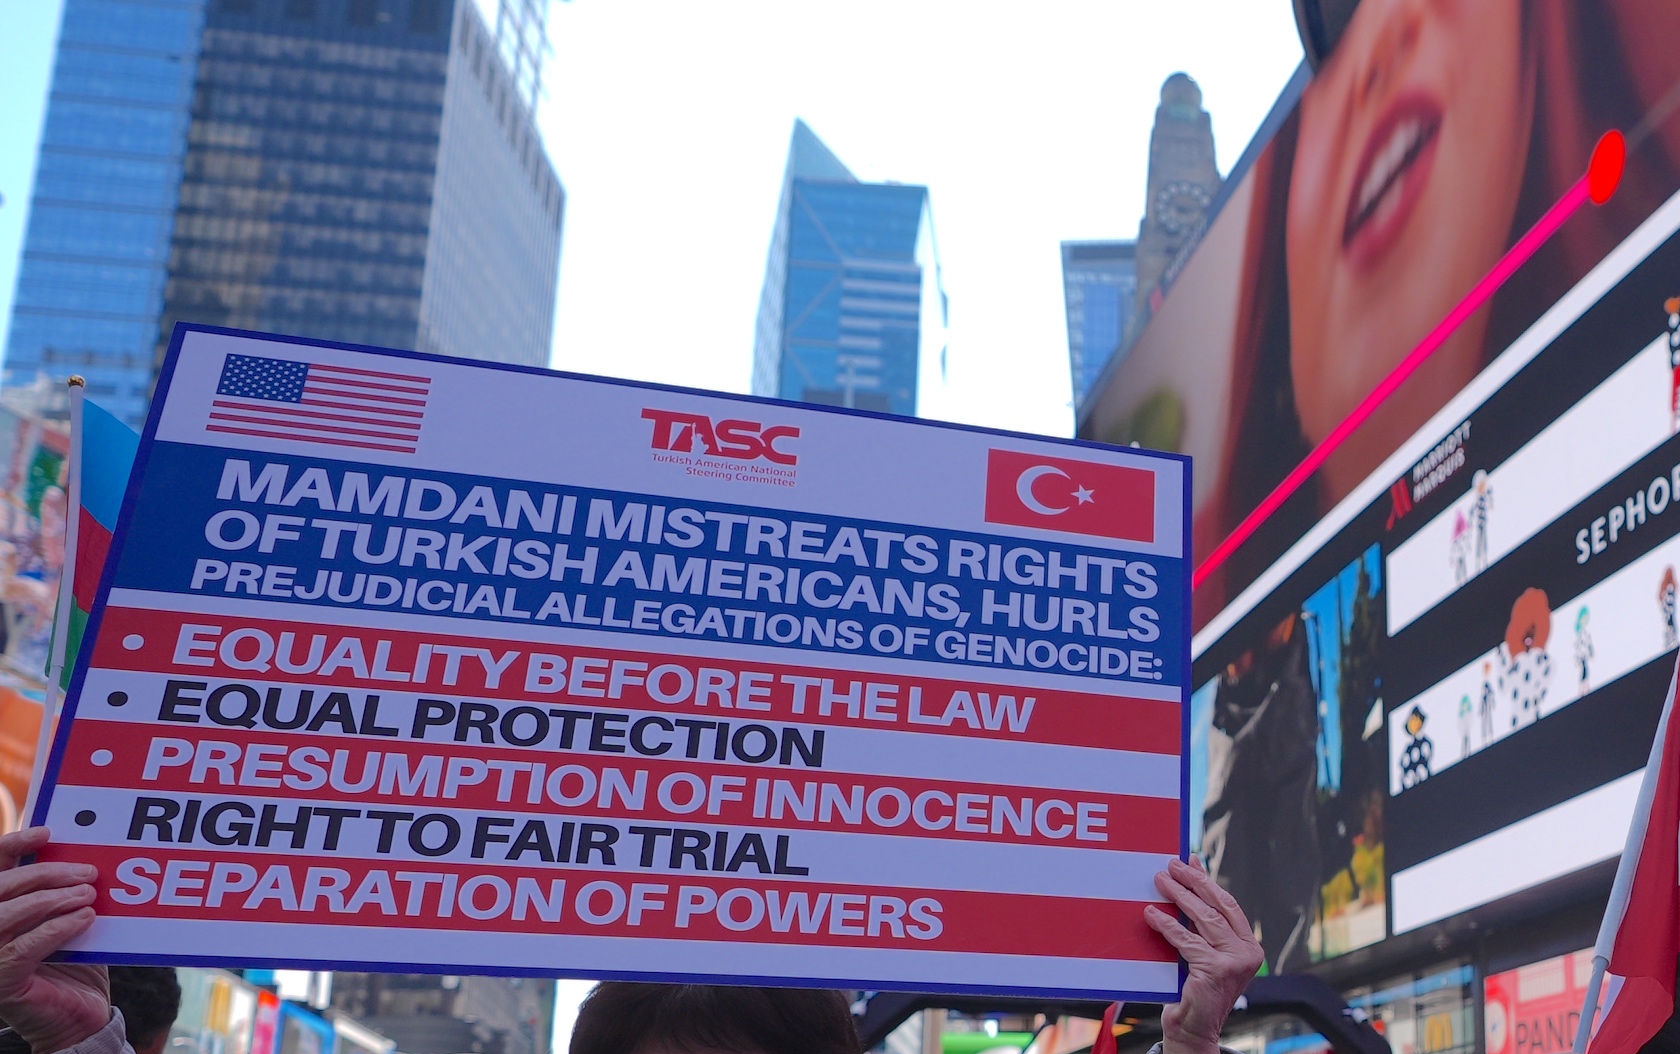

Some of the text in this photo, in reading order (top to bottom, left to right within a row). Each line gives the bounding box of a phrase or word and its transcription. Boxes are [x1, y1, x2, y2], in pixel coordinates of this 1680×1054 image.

[641, 408, 800, 466] TASC
[652, 453, 797, 478] Turkish American National
[686, 467, 795, 487] Steering Committee
[1412, 420, 1471, 482] MARRIOTT
[216, 458, 1159, 598] MAMDANI MISTREATS RIGHTS
[205, 510, 1161, 642] OF TURKISH AMERICANS, HURLS
[190, 559, 1164, 680] PREJUDICIAL ALLEGATIONS OF GENOCIDE:
[172, 623, 1036, 733] EQUALITY BEFORE THE LAW
[158, 680, 825, 767] EQUAL PROTECTION
[141, 737, 1109, 842] PRESUMPTION OF INNOCENCE
[127, 796, 809, 876] RIGHT TO FAIR TRIAL
[109, 857, 944, 940] SEPARATION OF POWERS
